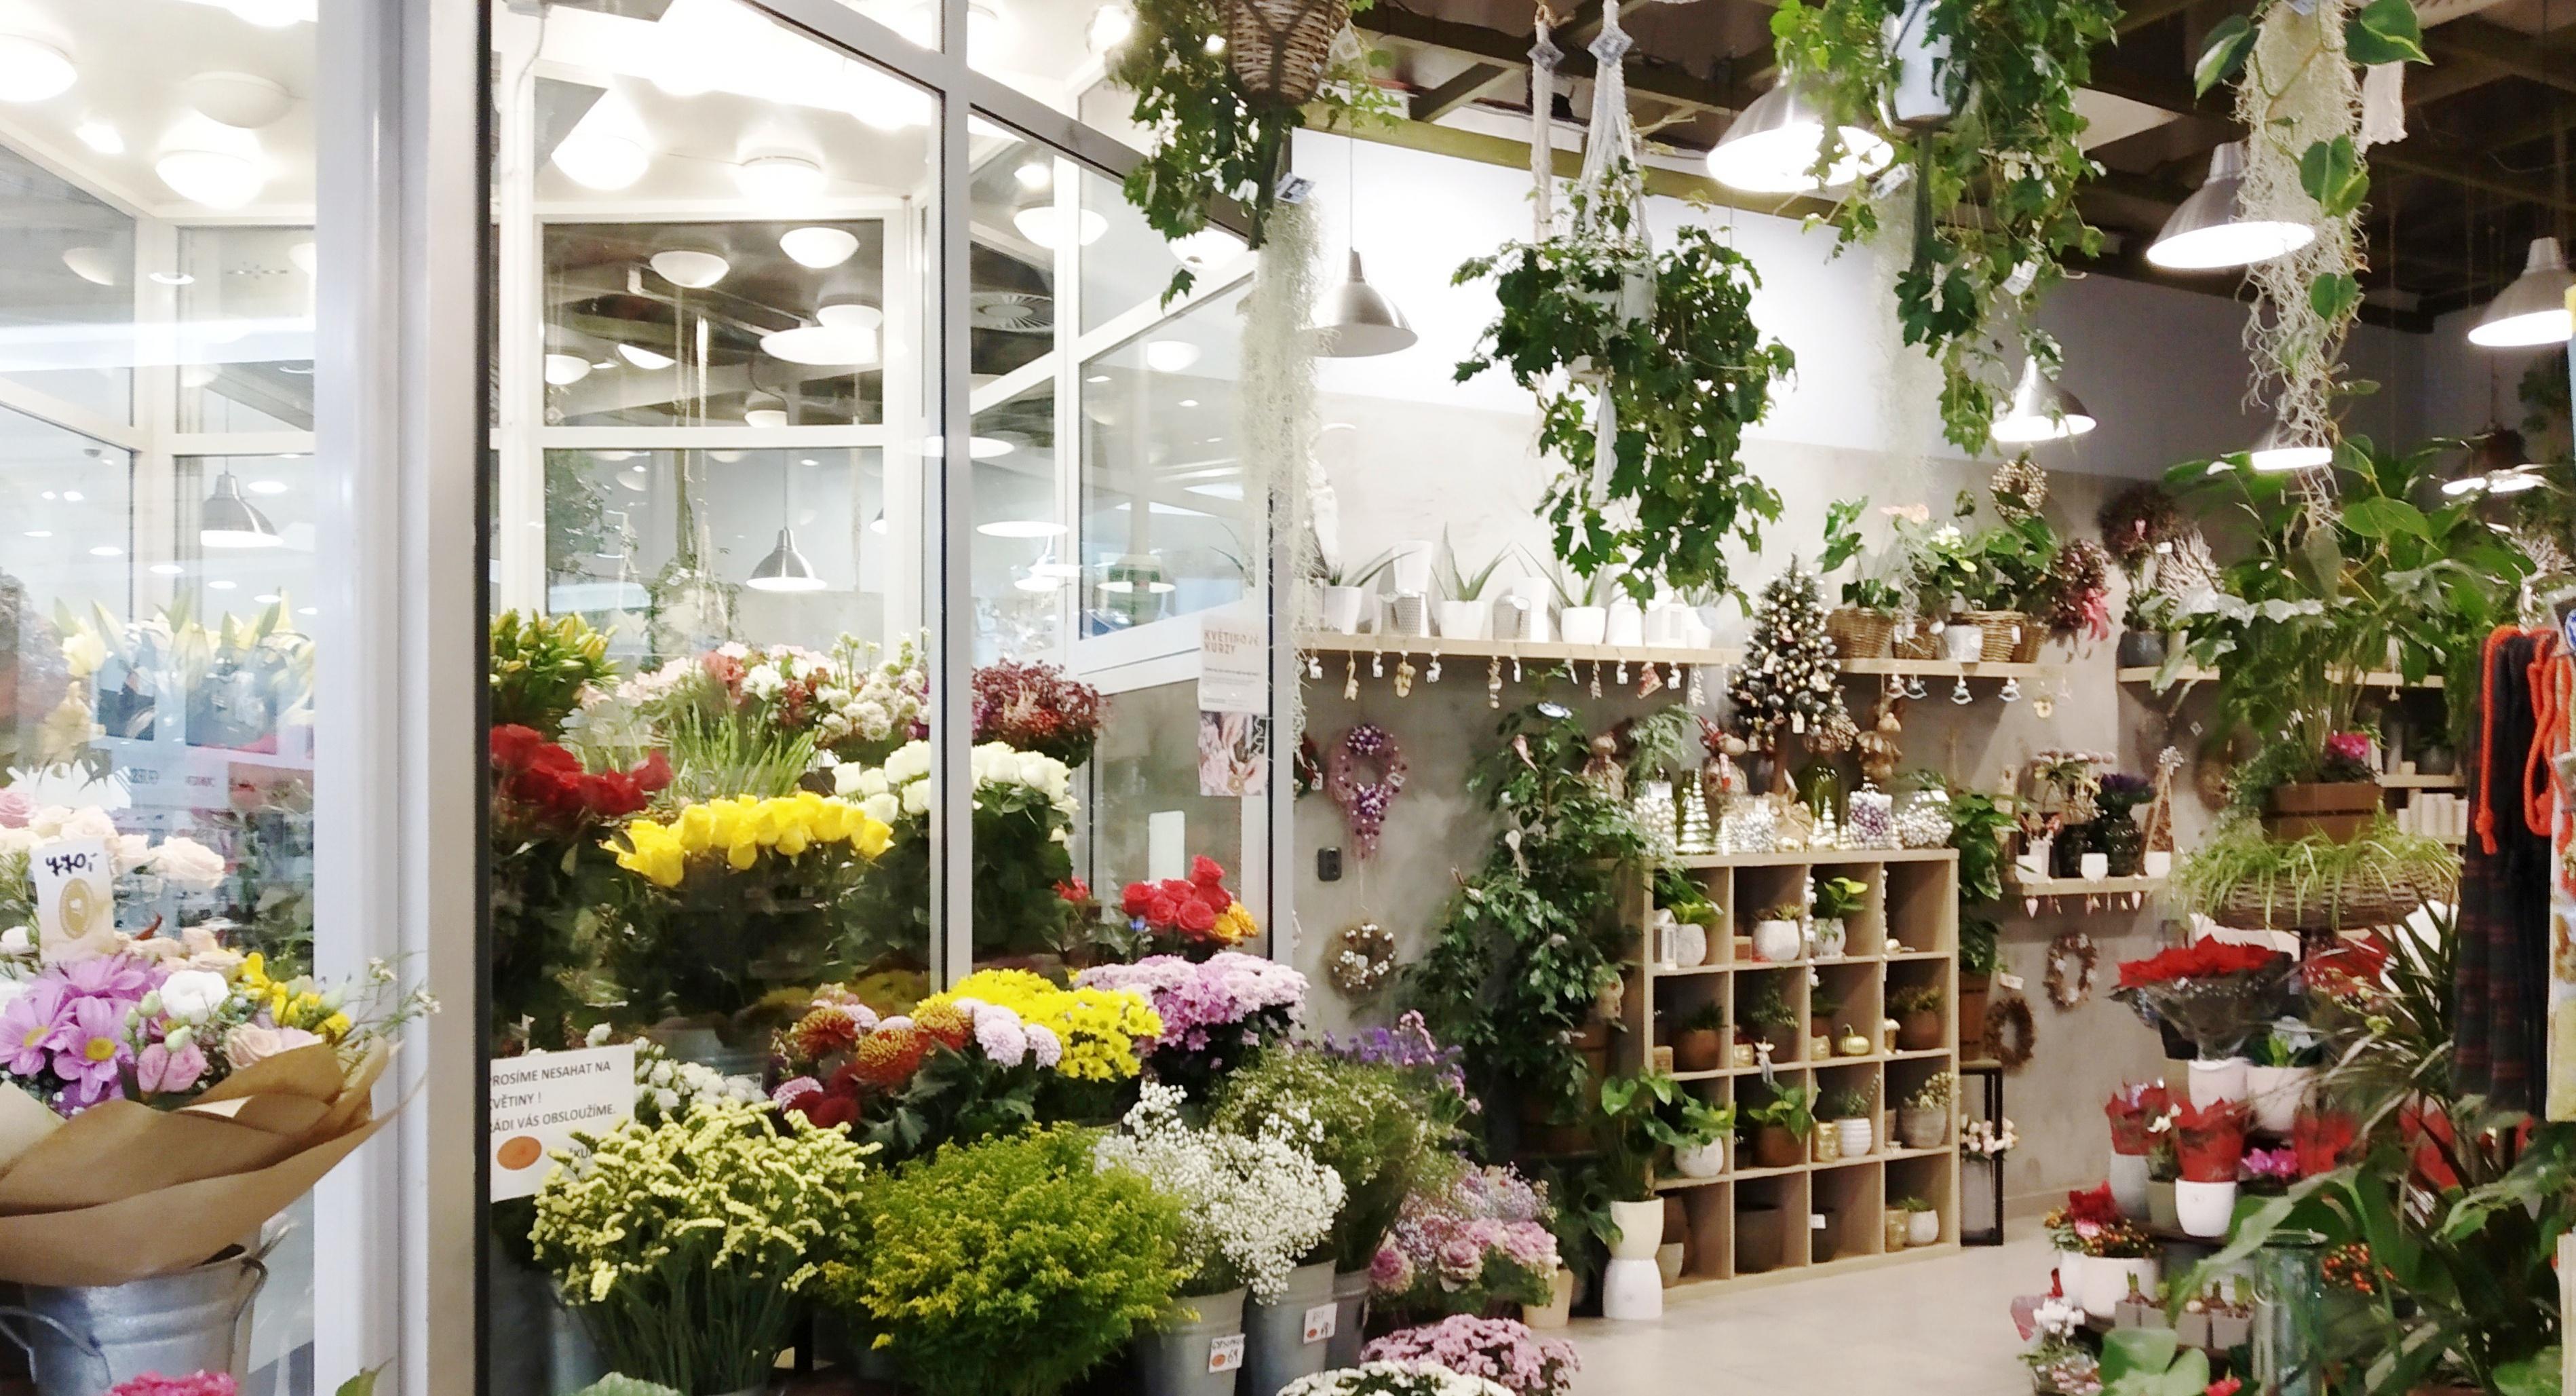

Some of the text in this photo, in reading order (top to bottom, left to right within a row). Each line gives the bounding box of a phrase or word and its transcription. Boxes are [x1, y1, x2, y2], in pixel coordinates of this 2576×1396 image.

[1204, 641, 1235, 654] KURZY
[490, 1061, 611, 1086] ROSÍME NESAHAT NA
[517, 1115, 539, 1129] VÁS
[542, 1103, 617, 1125] OBSLOUŽÍME.
